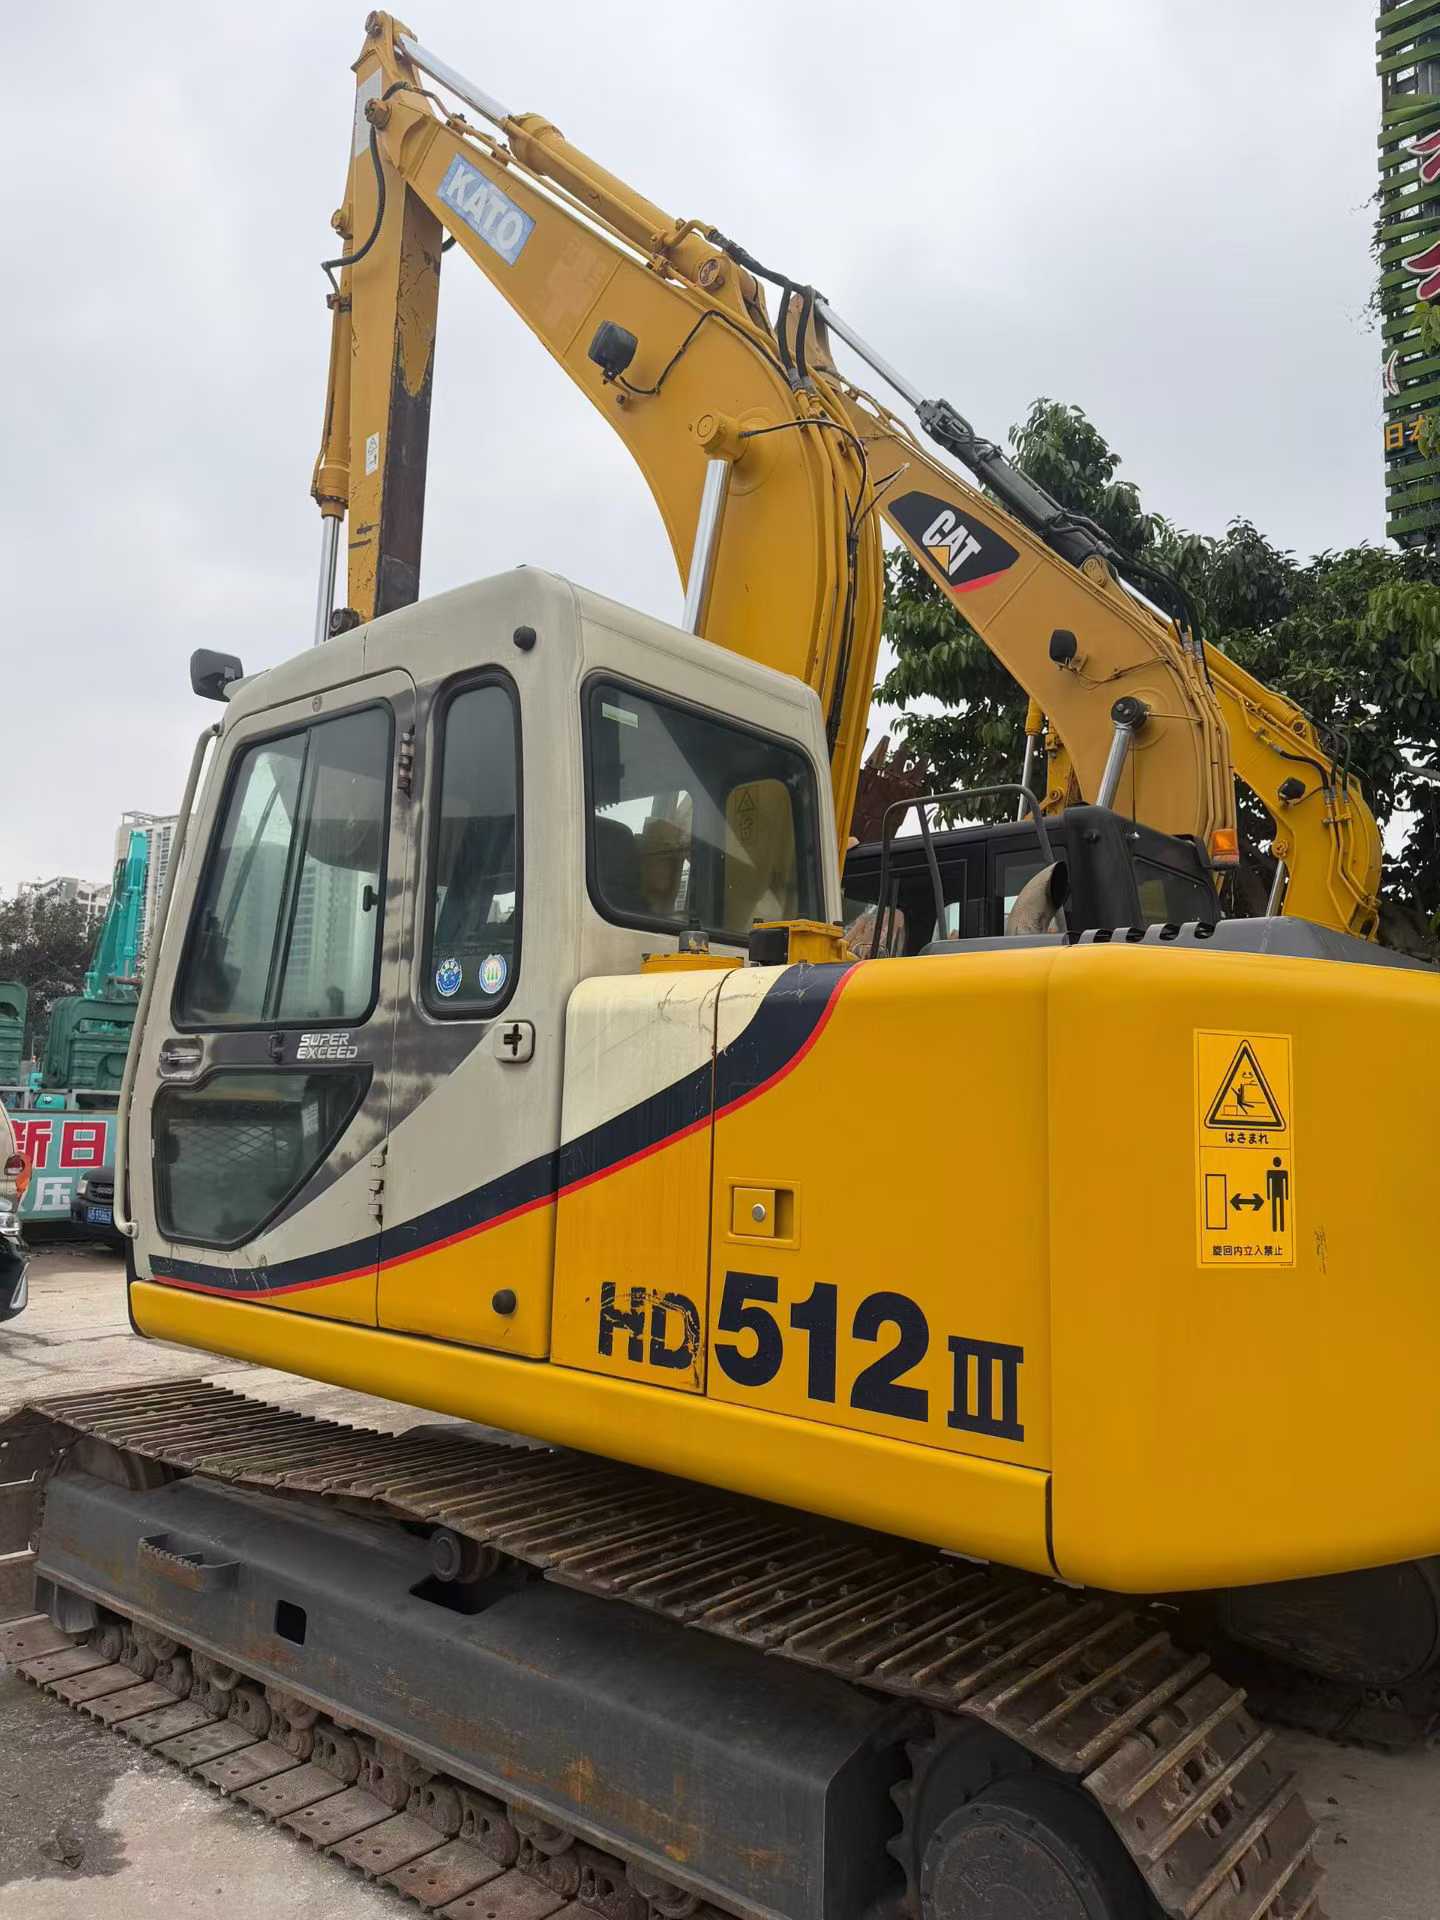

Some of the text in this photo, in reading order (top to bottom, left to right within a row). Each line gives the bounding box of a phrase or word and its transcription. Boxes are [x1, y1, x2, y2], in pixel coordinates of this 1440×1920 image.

[446, 163, 525, 250] KATO
[922, 509, 982, 577] CAT
[299, 1032, 350, 1046] SUPER
[296, 1045, 358, 1060] EXCEED
[1225, 1131, 1269, 1145] はさまれ
